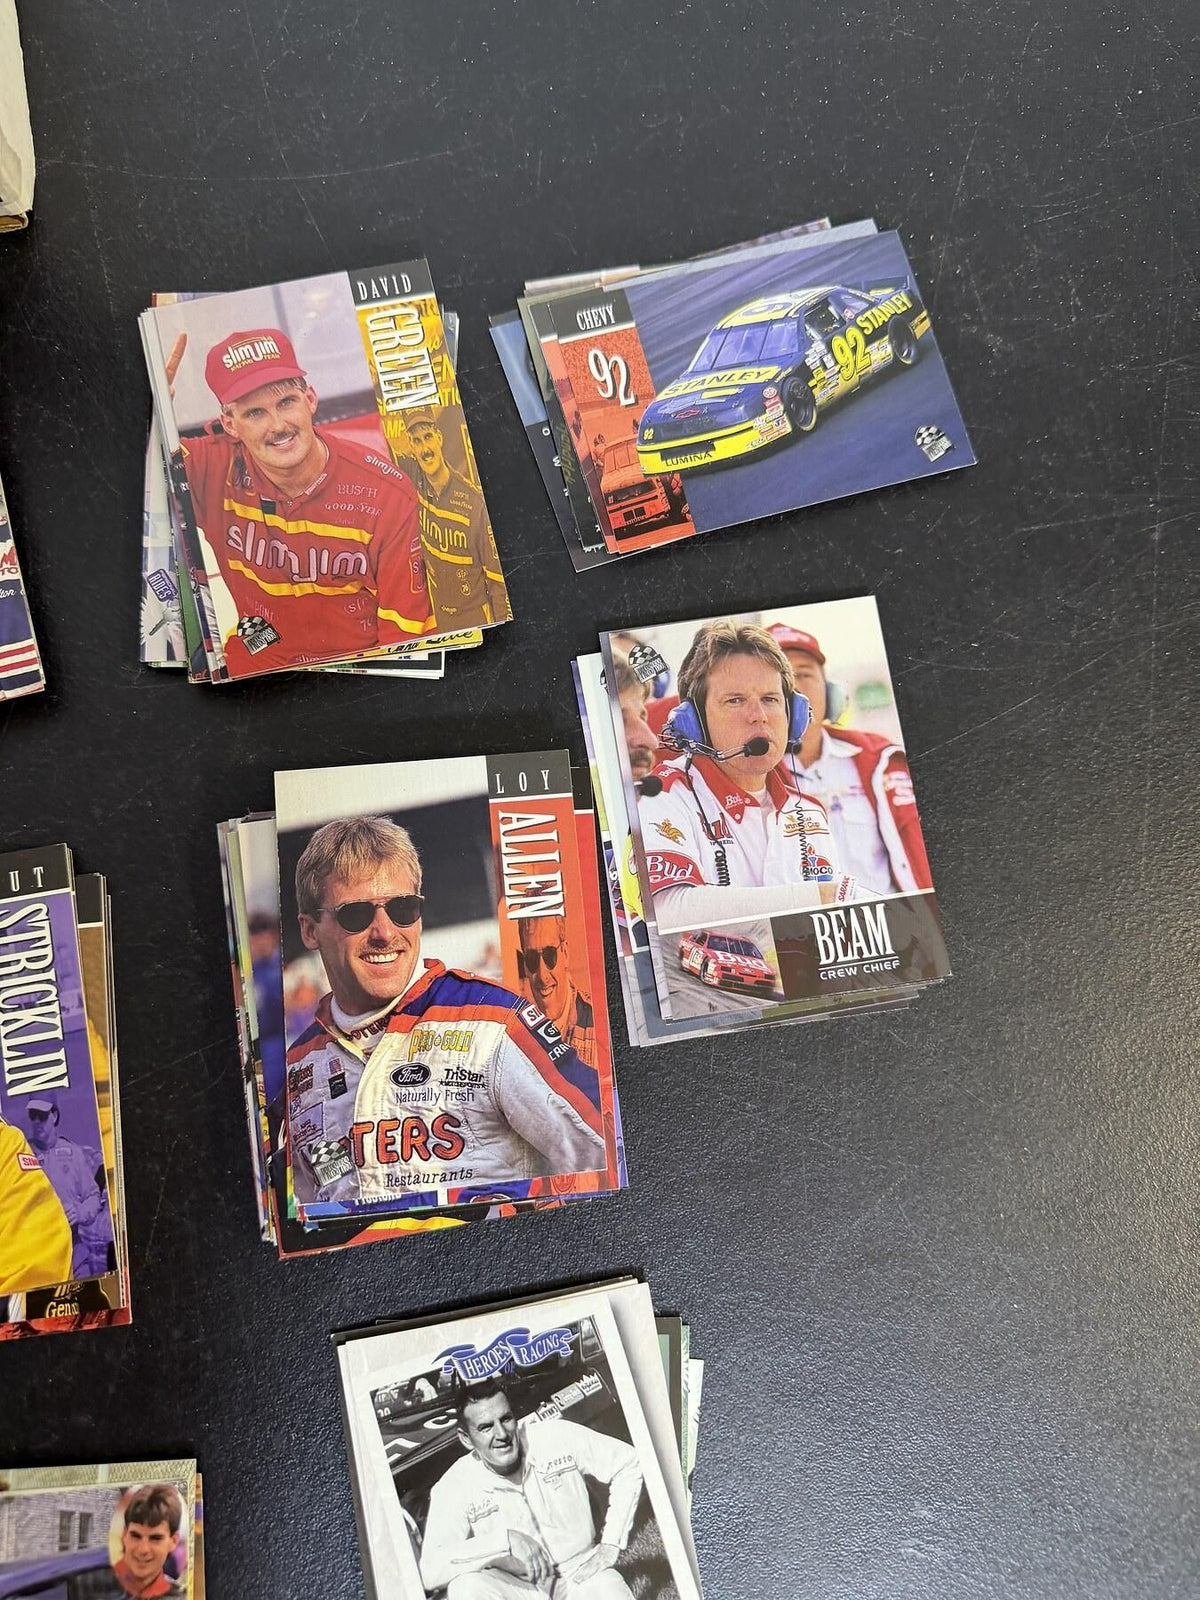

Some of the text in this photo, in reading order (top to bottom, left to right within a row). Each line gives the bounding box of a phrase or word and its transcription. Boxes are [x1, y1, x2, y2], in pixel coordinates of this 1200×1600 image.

[357, 273, 412, 300] DAVID
[576, 305, 617, 331] CHEVY
[855, 291, 914, 336] STANLEY
[366, 307, 441, 412] GREEN
[831, 326, 872, 382] 92
[587, 349, 637, 407] 92
[664, 369, 772, 396] STANLEY
[665, 450, 713, 467] LUMINA
[338, 484, 378, 498] BUSCH
[495, 769, 550, 794] LOY
[498, 810, 567, 920] ALLEN
[646, 854, 694, 880] Bud
[809, 902, 896, 967] BEAM
[819, 959, 901, 981] CREW CHIEF
[0, 902, 70, 1097] STRICKLIN
[397, 1066, 424, 1083] Ford
[444, 1066, 485, 1083] TriStar
[395, 1087, 475, 1107] Naturally Fresh
[385, 1166, 474, 1188] Restaurants
[463, 1339, 513, 1379] HEROES
[519, 1332, 560, 1364] RACING
